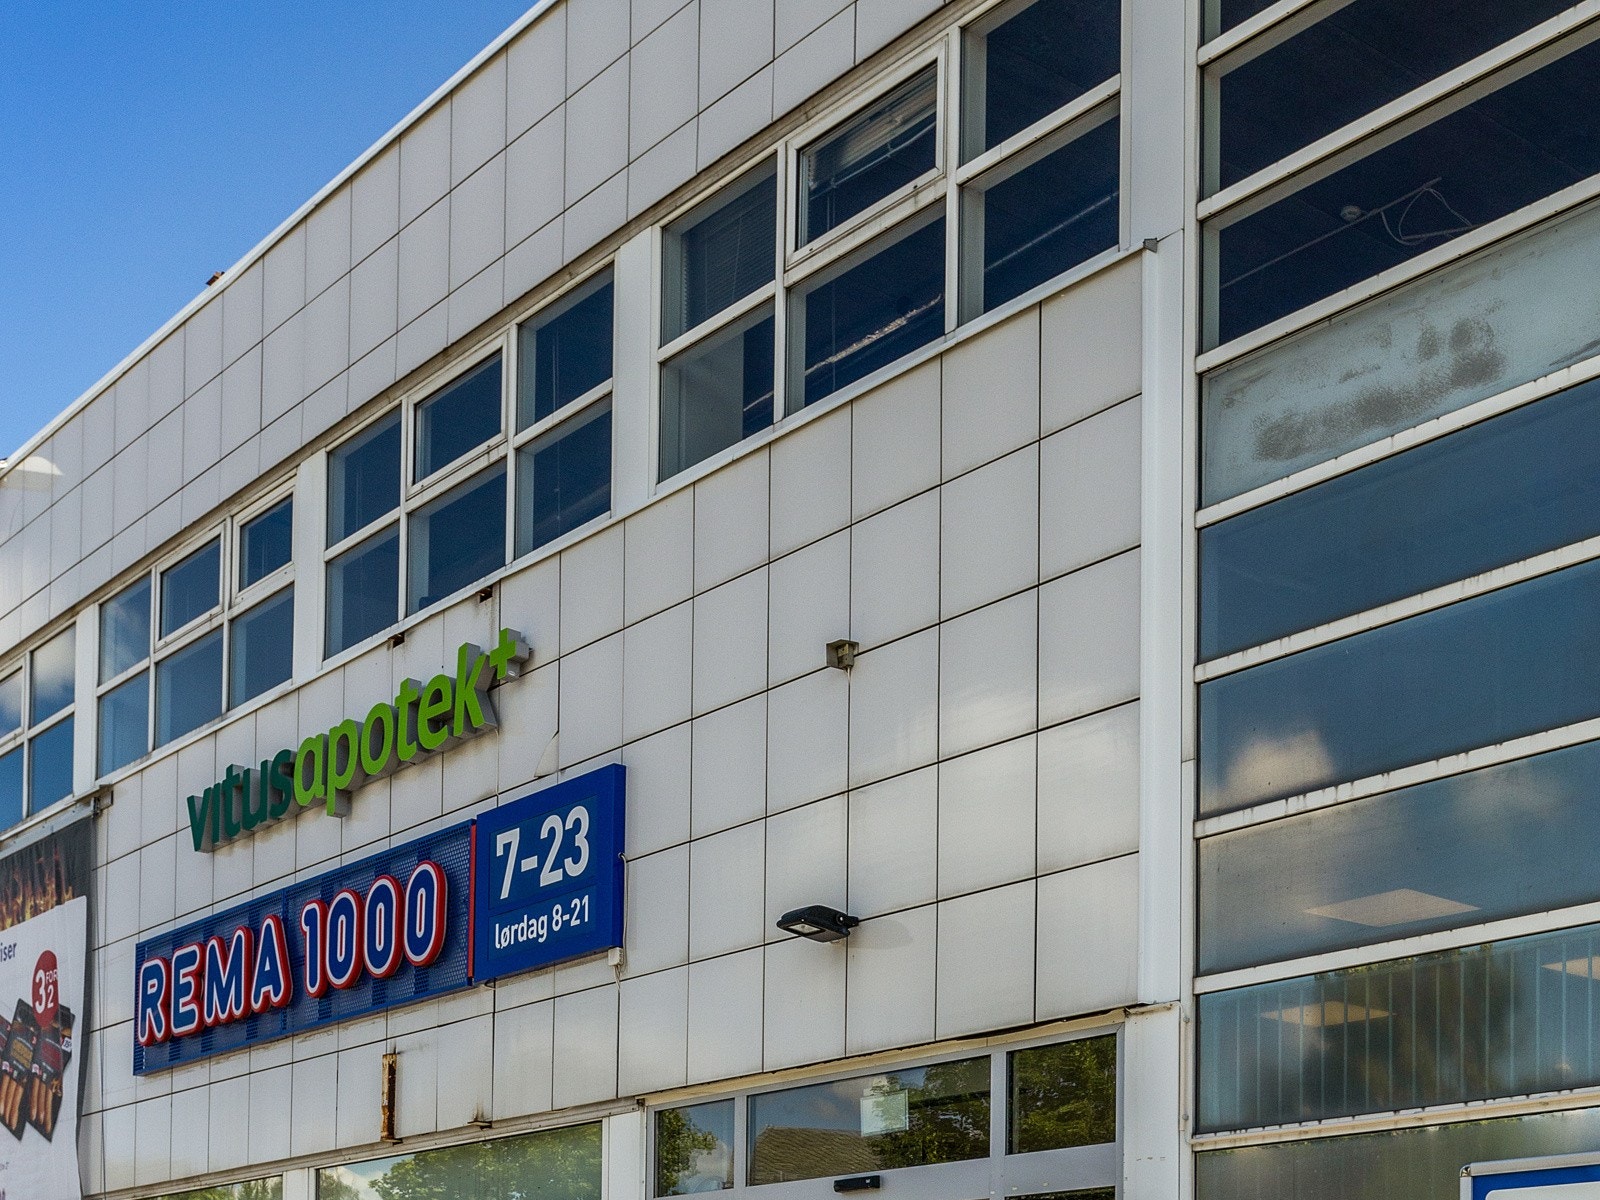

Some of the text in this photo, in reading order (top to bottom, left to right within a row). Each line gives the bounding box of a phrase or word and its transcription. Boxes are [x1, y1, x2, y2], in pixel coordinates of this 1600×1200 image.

[495, 805, 590, 900] 7-23
[494, 895, 590, 950] lørdag 8-21
[136, 860, 448, 1047] REMA 1000
[35, 969, 58, 1014] 3 FOR
[47, 984, 54, 1009] 2
